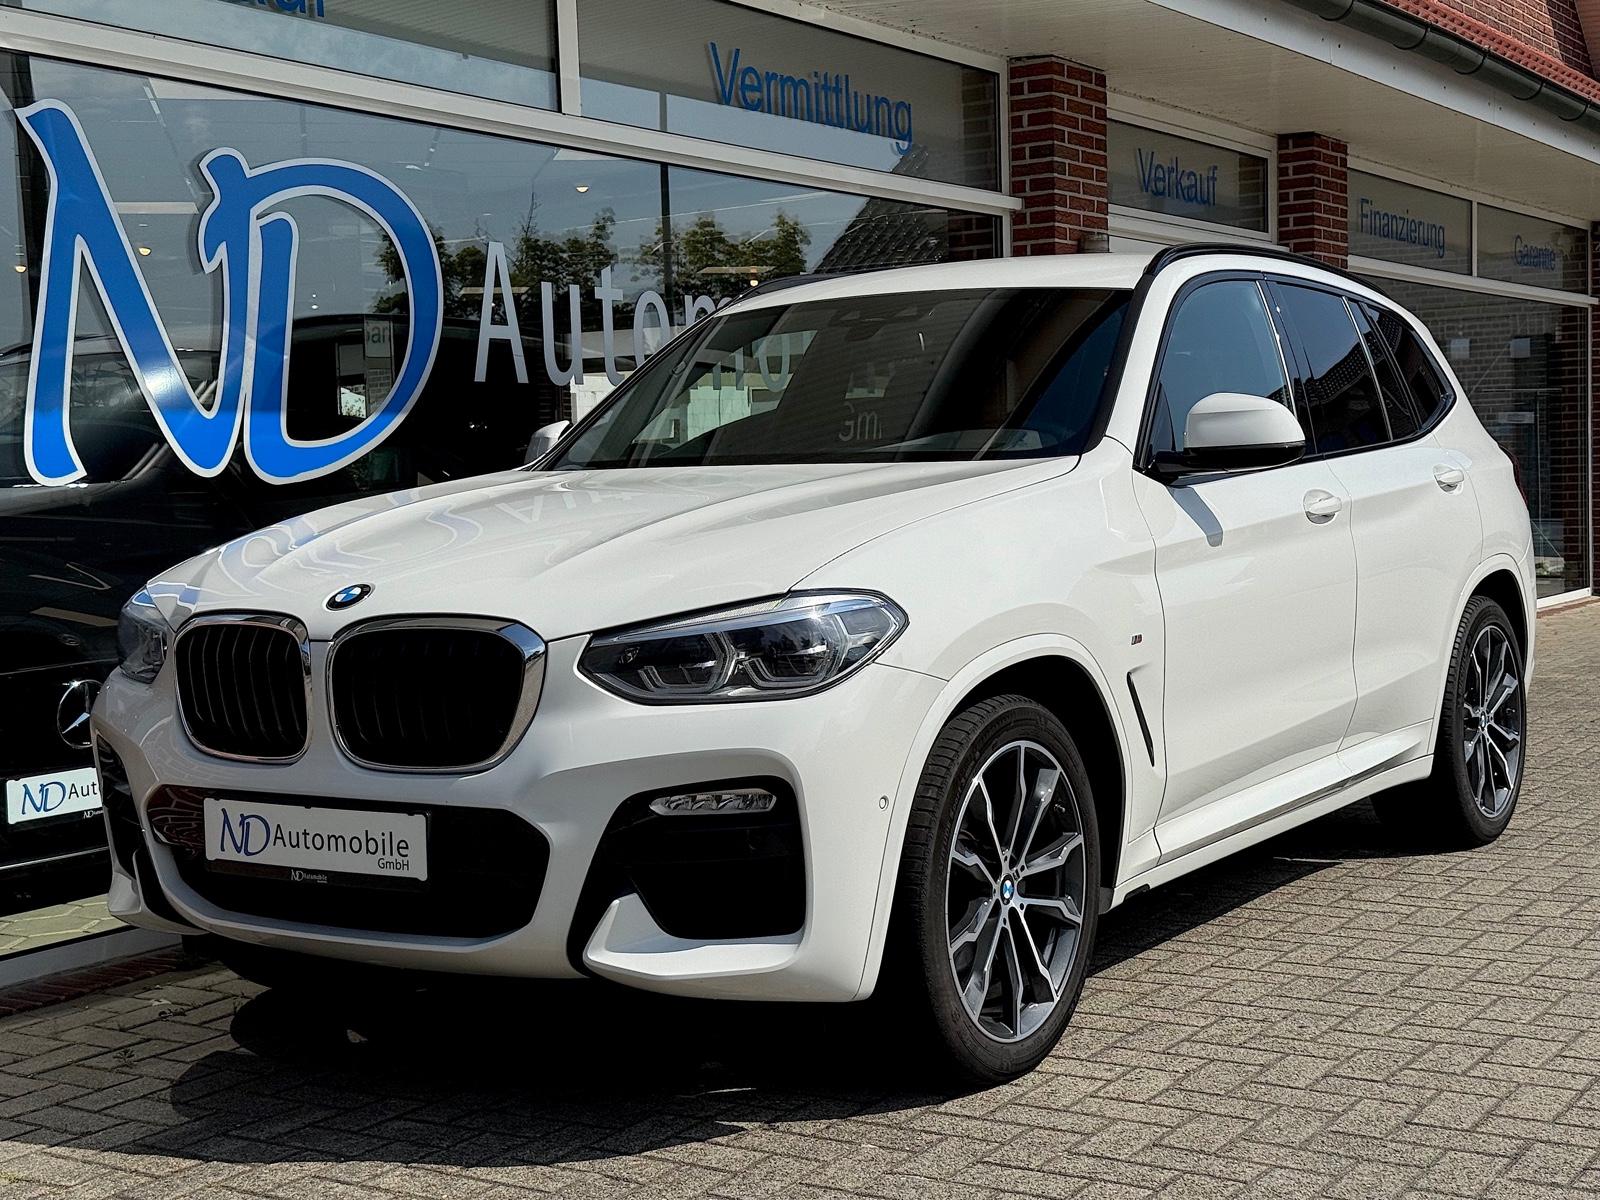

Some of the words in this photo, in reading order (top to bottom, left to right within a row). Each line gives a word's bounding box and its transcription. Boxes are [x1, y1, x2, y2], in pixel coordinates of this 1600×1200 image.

[708, 41, 914, 156] Vermittlung
[1137, 148, 1218, 207] Verkauf
[1360, 198, 1446, 258] Finanzierung
[14, 98, 444, 486] ND
[21, 781, 67, 815] ND
[220, 807, 270, 857] ND
[272, 823, 410, 858] Automobile
[377, 857, 410, 872] GmbH
